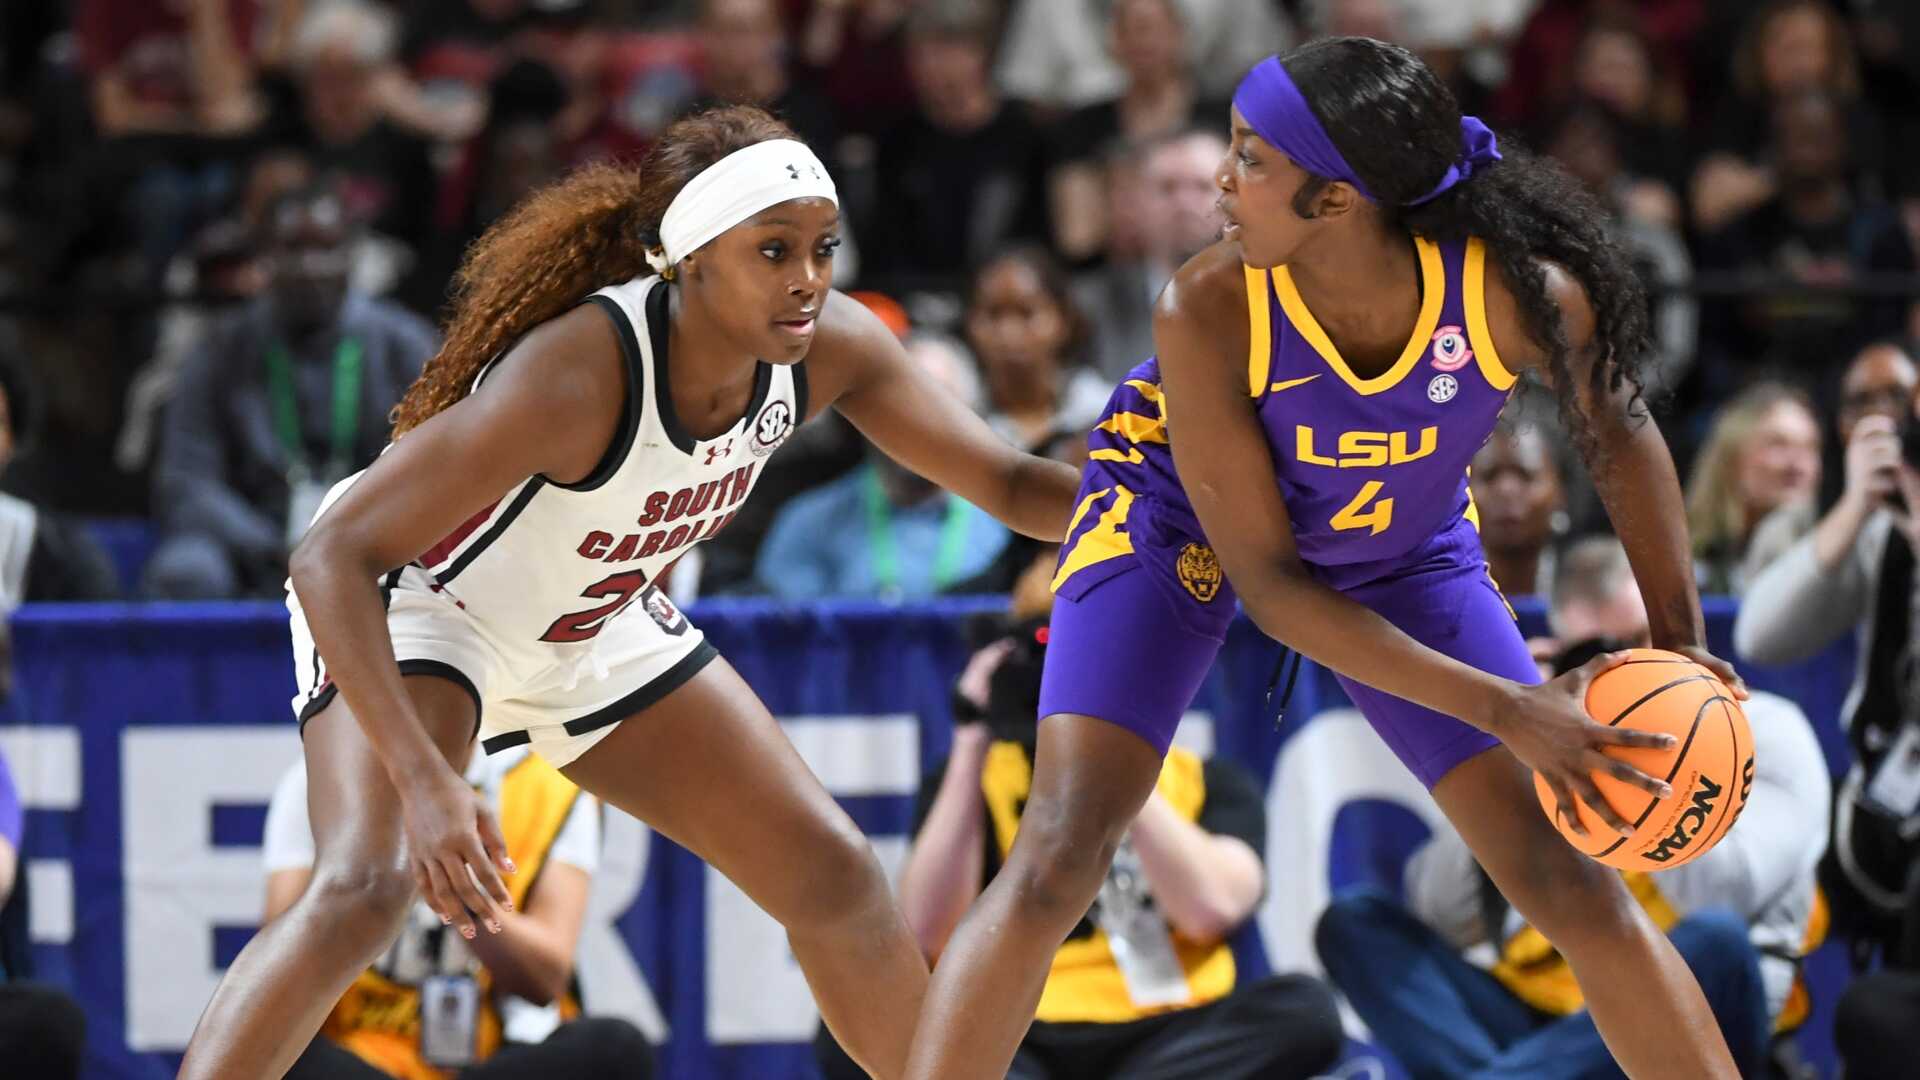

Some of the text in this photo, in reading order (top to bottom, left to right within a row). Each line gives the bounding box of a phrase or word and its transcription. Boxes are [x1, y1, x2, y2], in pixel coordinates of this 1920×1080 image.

[758, 402, 789, 444] SEC
[1296, 424, 1438, 468] LSU
[638, 461, 755, 527] SOUTH
[1329, 480, 1394, 536] 4
[1641, 774, 1722, 862] NCAA
